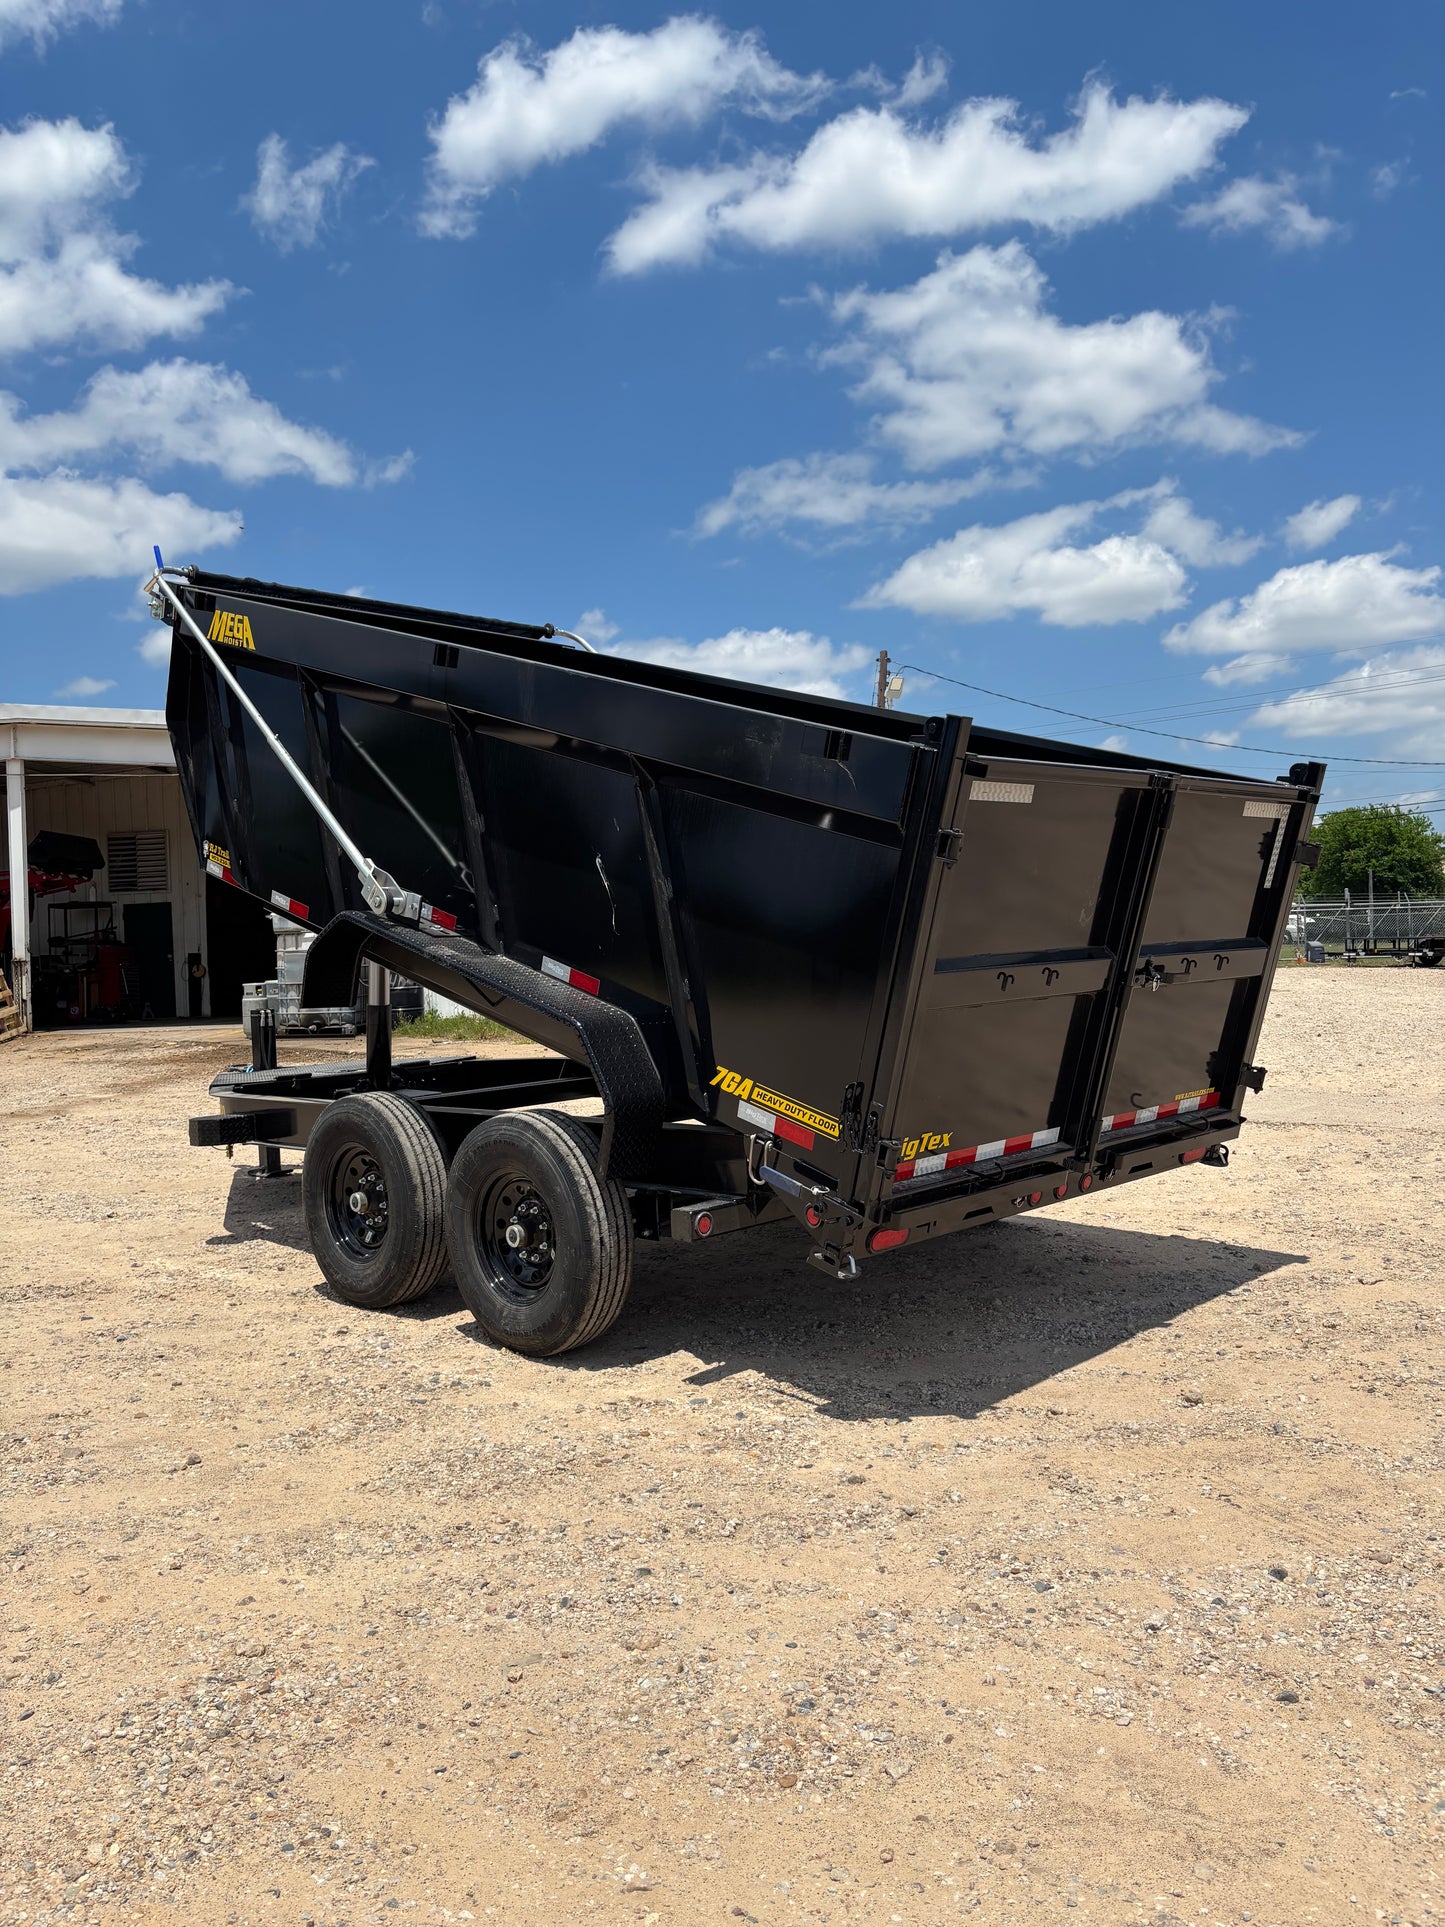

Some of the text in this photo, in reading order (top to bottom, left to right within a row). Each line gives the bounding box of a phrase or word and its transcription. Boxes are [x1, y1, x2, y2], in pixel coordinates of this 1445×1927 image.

[207, 610, 256, 651] MEGA
[224, 636, 243, 647] HOIST
[709, 1065, 754, 1100] 7GA
[756, 1091, 837, 1132] HEAVY DUTY FLOOR
[900, 1131, 953, 1161] igTex
